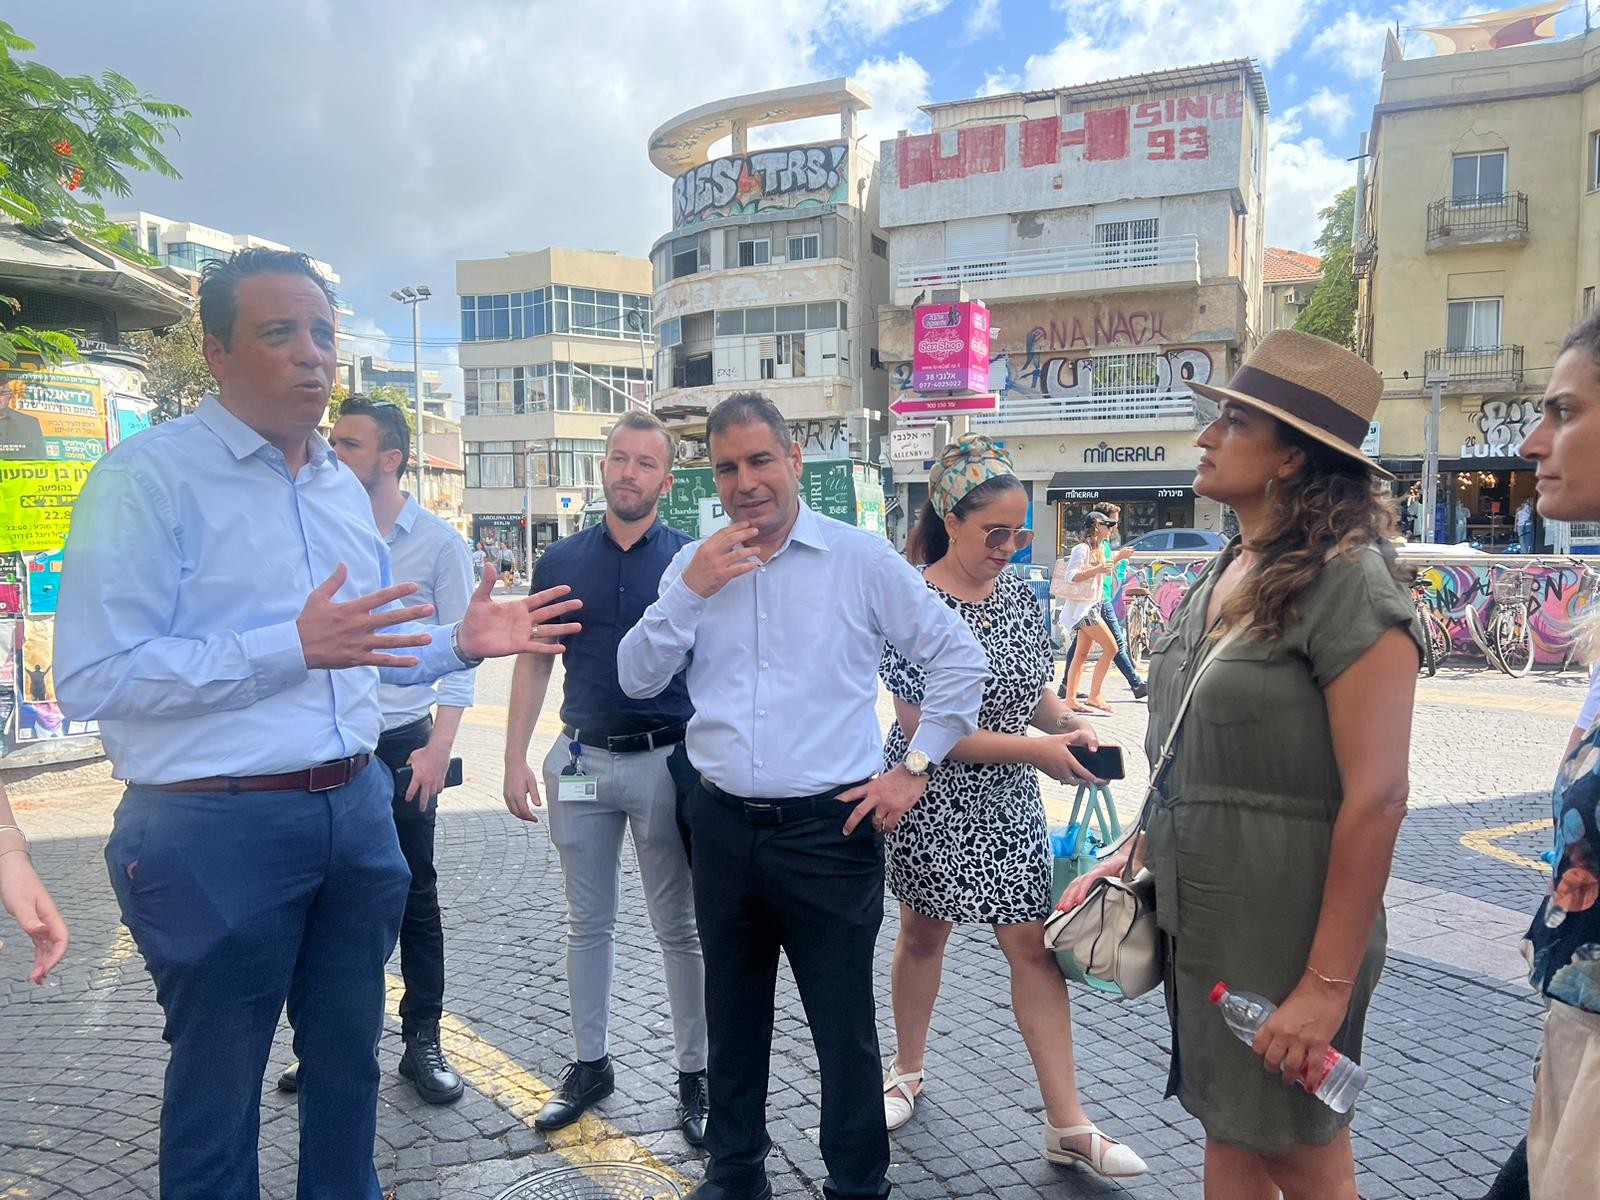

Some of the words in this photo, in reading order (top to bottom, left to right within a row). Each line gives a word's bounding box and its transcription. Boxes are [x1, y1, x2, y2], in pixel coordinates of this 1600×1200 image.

[1134, 91, 1243, 128] SINCE
[920, 342, 938, 351] Sex
[939, 340, 962, 351] Shop
[936, 371, 956, 380] אלנבי
[893, 432, 918, 441] אלנבי
[894, 450, 922, 458] ALLENBY
[1460, 443, 1521, 458] LUKK
[55, 468, 70, 482] בן
[38, 484, 73, 492] בהופעה
[810, 472, 822, 512] PIRIT
[1158, 489, 1183, 498] מינרלה
